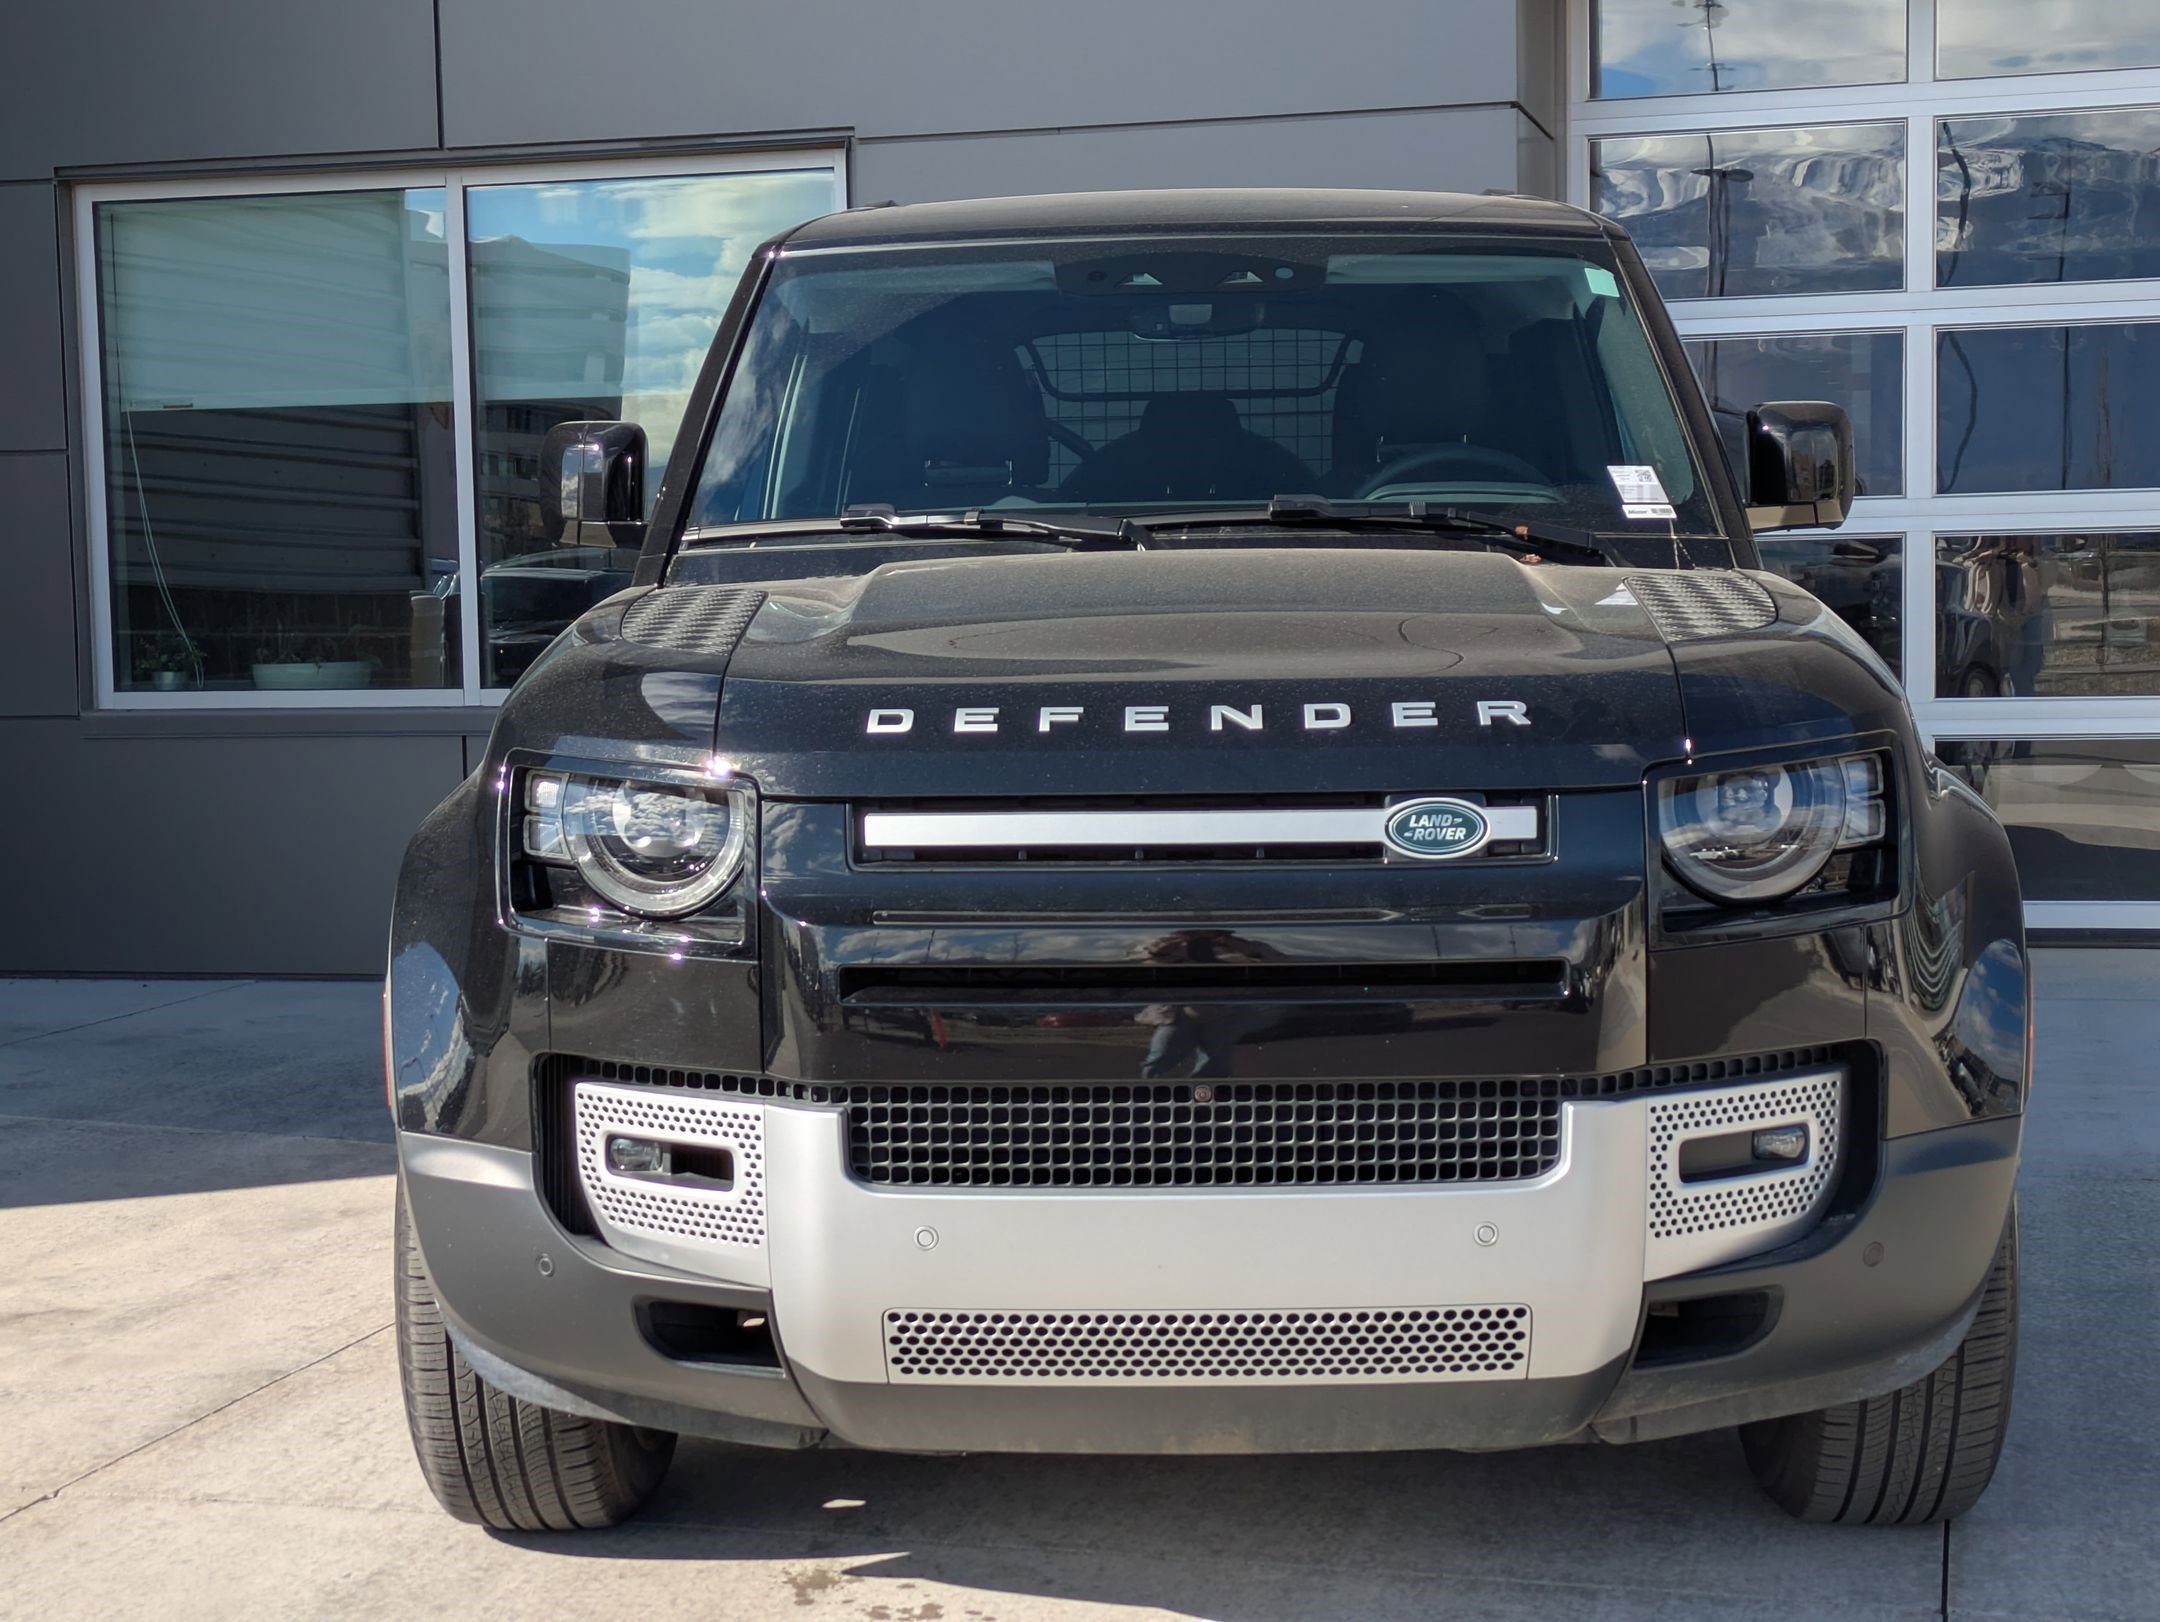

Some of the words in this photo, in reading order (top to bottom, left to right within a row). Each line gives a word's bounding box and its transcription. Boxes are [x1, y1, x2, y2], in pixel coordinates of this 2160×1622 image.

[866, 700, 1531, 734] DEFENDER
[1409, 814, 1453, 828] LAND
[1413, 827, 1467, 841] ROVER
